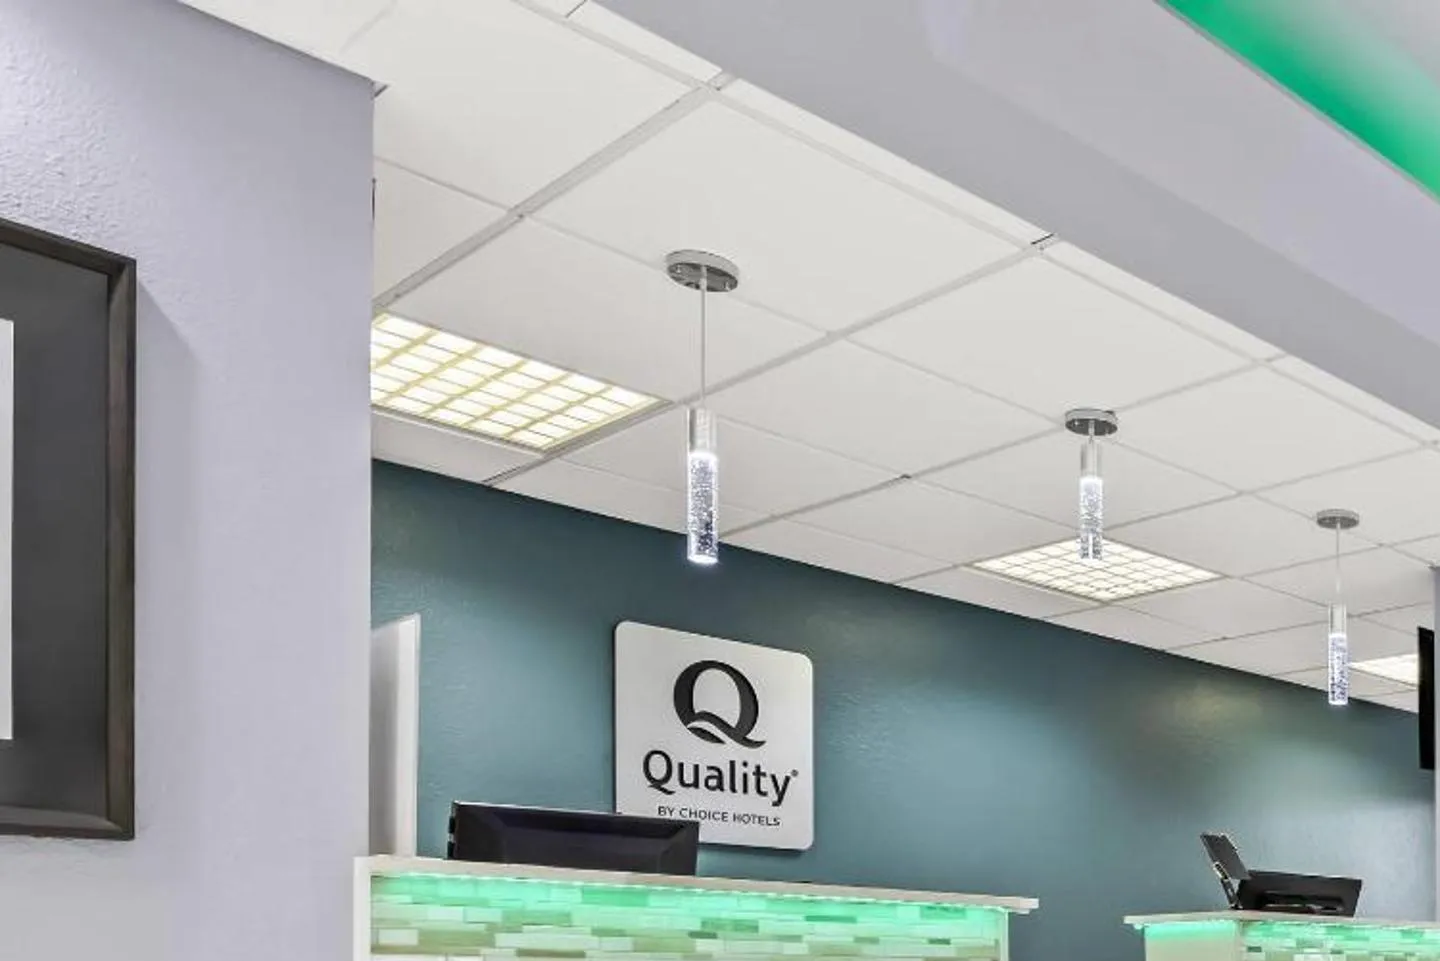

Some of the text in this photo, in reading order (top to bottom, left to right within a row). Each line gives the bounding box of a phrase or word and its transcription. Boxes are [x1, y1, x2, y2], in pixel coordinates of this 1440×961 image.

[673, 660, 767, 749] Q
[643, 750, 791, 807] Quality
[657, 805, 781, 827] BY CHOICE HOTELS
